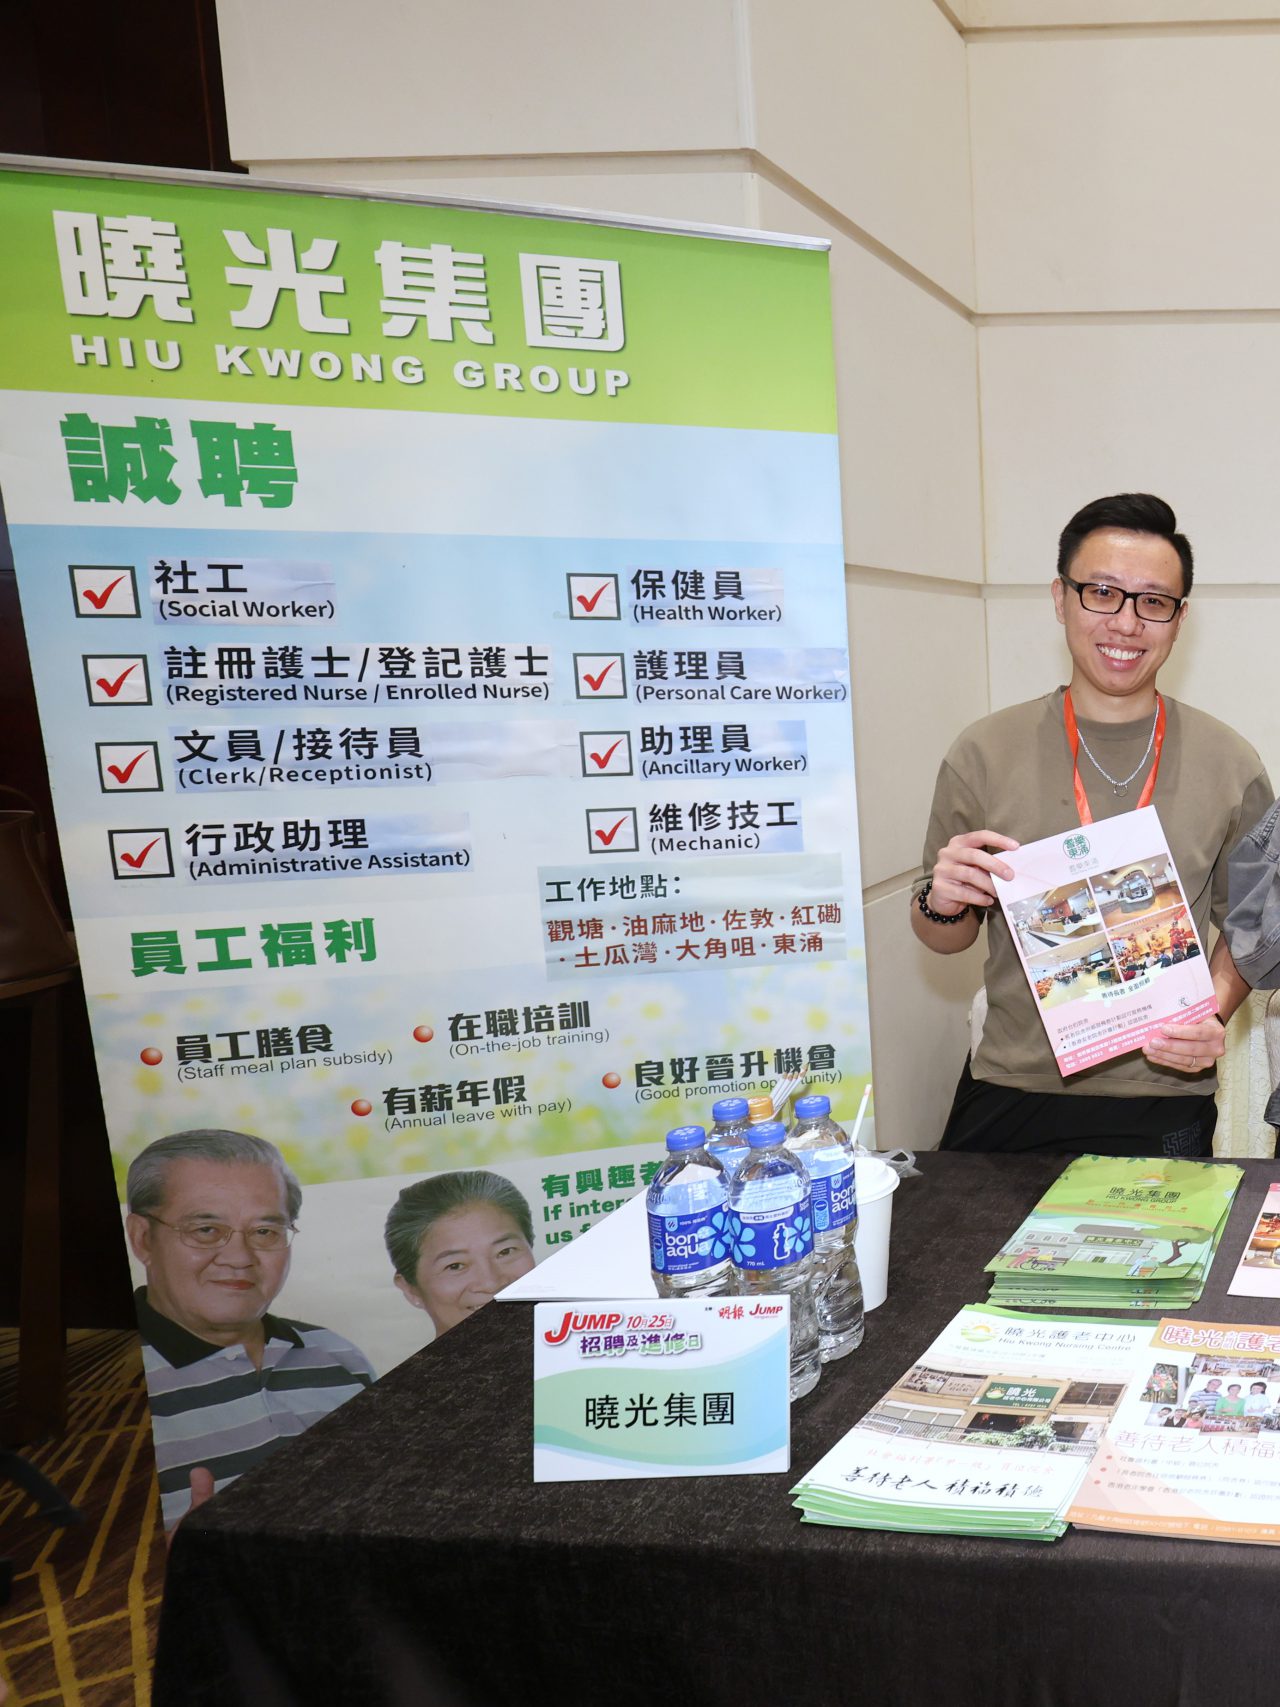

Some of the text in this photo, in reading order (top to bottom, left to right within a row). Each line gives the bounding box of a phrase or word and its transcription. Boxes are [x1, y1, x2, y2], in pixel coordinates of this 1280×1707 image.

[52, 210, 627, 352] 曉光集團
[70, 334, 630, 396] HIU KWONG GROUP
[59, 412, 299, 509] 誠聘
[154, 560, 248, 595] 社工
[630, 569, 746, 601] 保健員
[159, 600, 336, 621] (Social Worker)
[633, 604, 782, 624] (Health Worker)
[164, 645, 549, 682] 註冊護士/登記護士
[633, 650, 748, 681] 護理員
[166, 684, 298, 707] (Registered
[304, 685, 368, 701] Nurse
[387, 683, 478, 700] Enrolled
[483, 682, 550, 700] Nurse)
[636, 684, 847, 703] (Personal Care Worker)
[174, 727, 425, 764] 文員/接待員
[640, 724, 752, 756] 助理員
[178, 763, 433, 788] (Clerk/Receptionist)
[642, 755, 808, 779] (Ancillary Worker)
[648, 800, 798, 833] 維修技工
[185, 819, 369, 856] 行政助理
[651, 833, 761, 855] (Mechanic)
[189, 849, 471, 880] (Administrative Assistant)
[131, 917, 377, 977] 員工福利
[448, 1000, 592, 1042] 在職培訓
[176, 1024, 335, 1066] 員工膳食
[448, 1028, 610, 1060] (On-the-job training)
[177, 1049, 393, 1083] (Staff meal plan subsidy)
[634, 1043, 837, 1088] 良好晉升機會
[383, 1075, 527, 1116] 有薪年假
[635, 1085, 680, 1105] (Good
[685, 1080, 756, 1099] promotion
[384, 1098, 573, 1132] (Annual leave with pay)
[1109, 1186, 1181, 1200] 曉光集團
[543, 1204, 562, 1222] If
[545, 1230, 573, 1245] us
[749, 1303, 783, 1316] JUMP
[544, 1311, 621, 1344] JUMP
[580, 1332, 700, 1355] 招聘及進修日
[584, 1391, 735, 1430] 曉光集團
